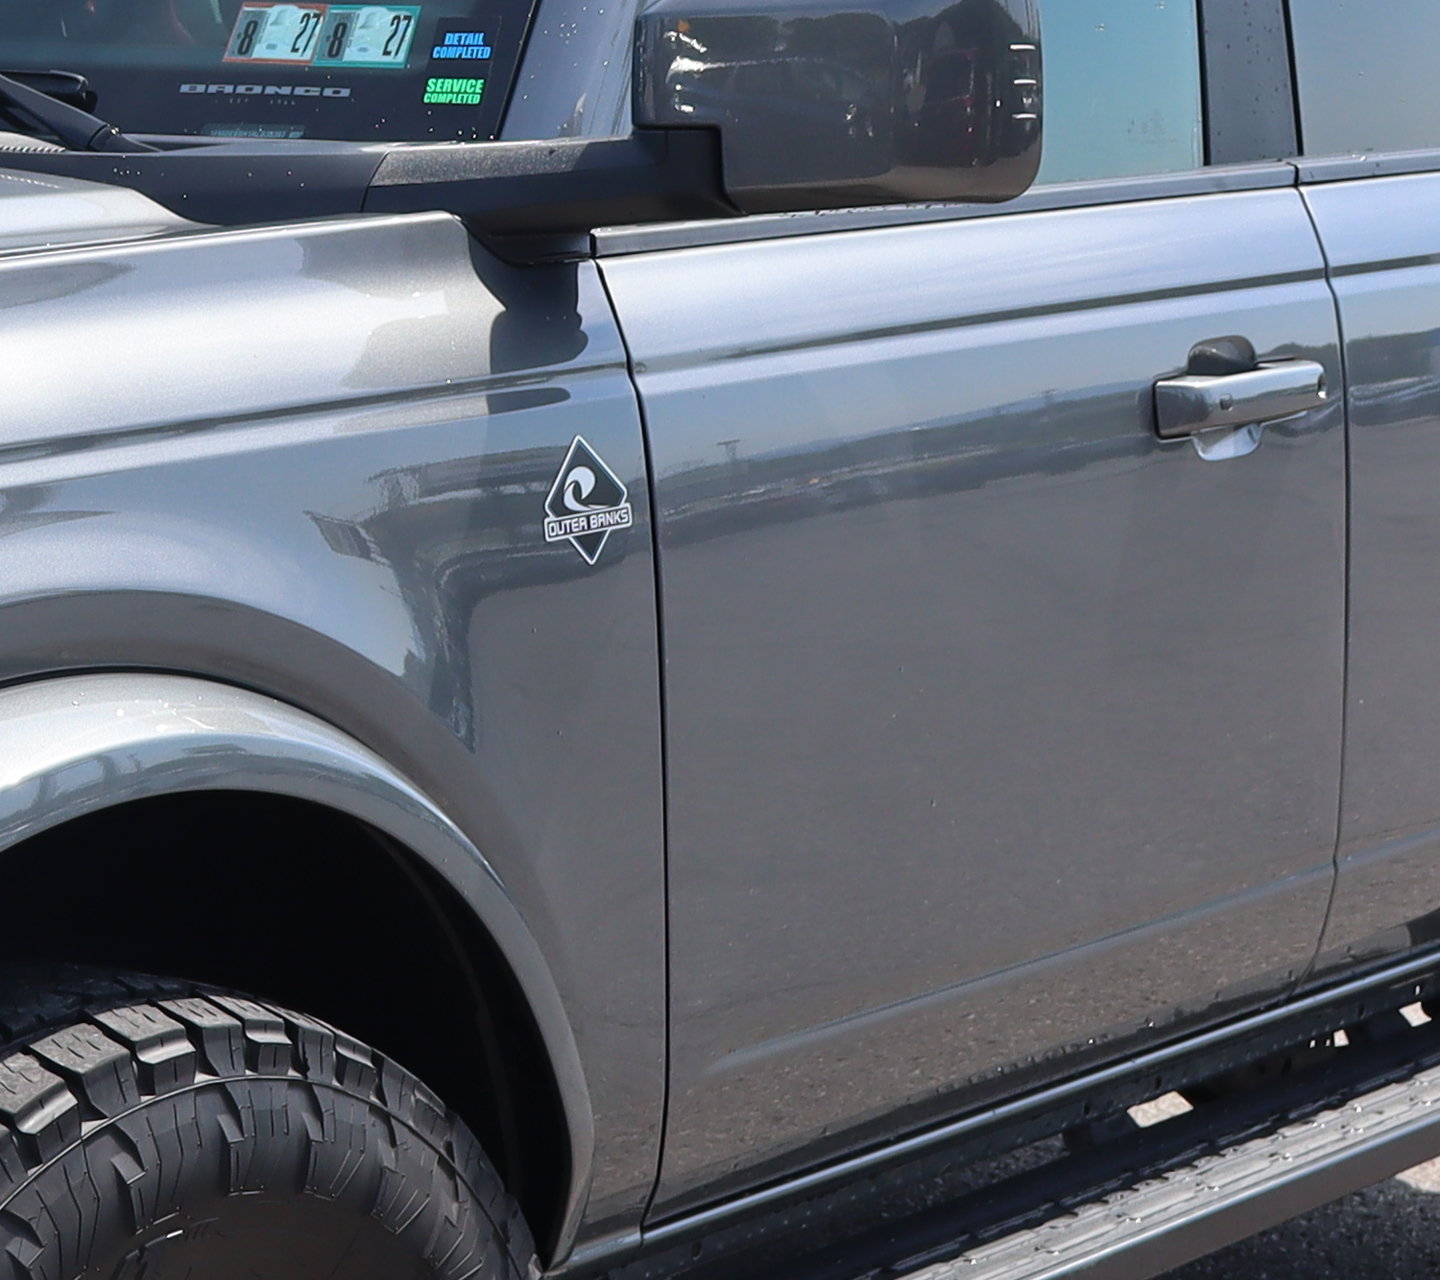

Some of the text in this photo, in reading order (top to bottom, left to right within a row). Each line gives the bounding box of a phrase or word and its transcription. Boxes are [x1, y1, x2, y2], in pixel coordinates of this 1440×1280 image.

[237, 12, 323, 58] 8 27
[327, 14, 413, 60] 8 27
[444, 32, 485, 46] DETAIL
[432, 46, 492, 59] COMPLETED
[179, 83, 351, 98] BRONCO
[426, 78, 485, 94] SERVICE
[423, 92, 481, 105] COMPLETED
[548, 508, 629, 537] OUTER BANKS
